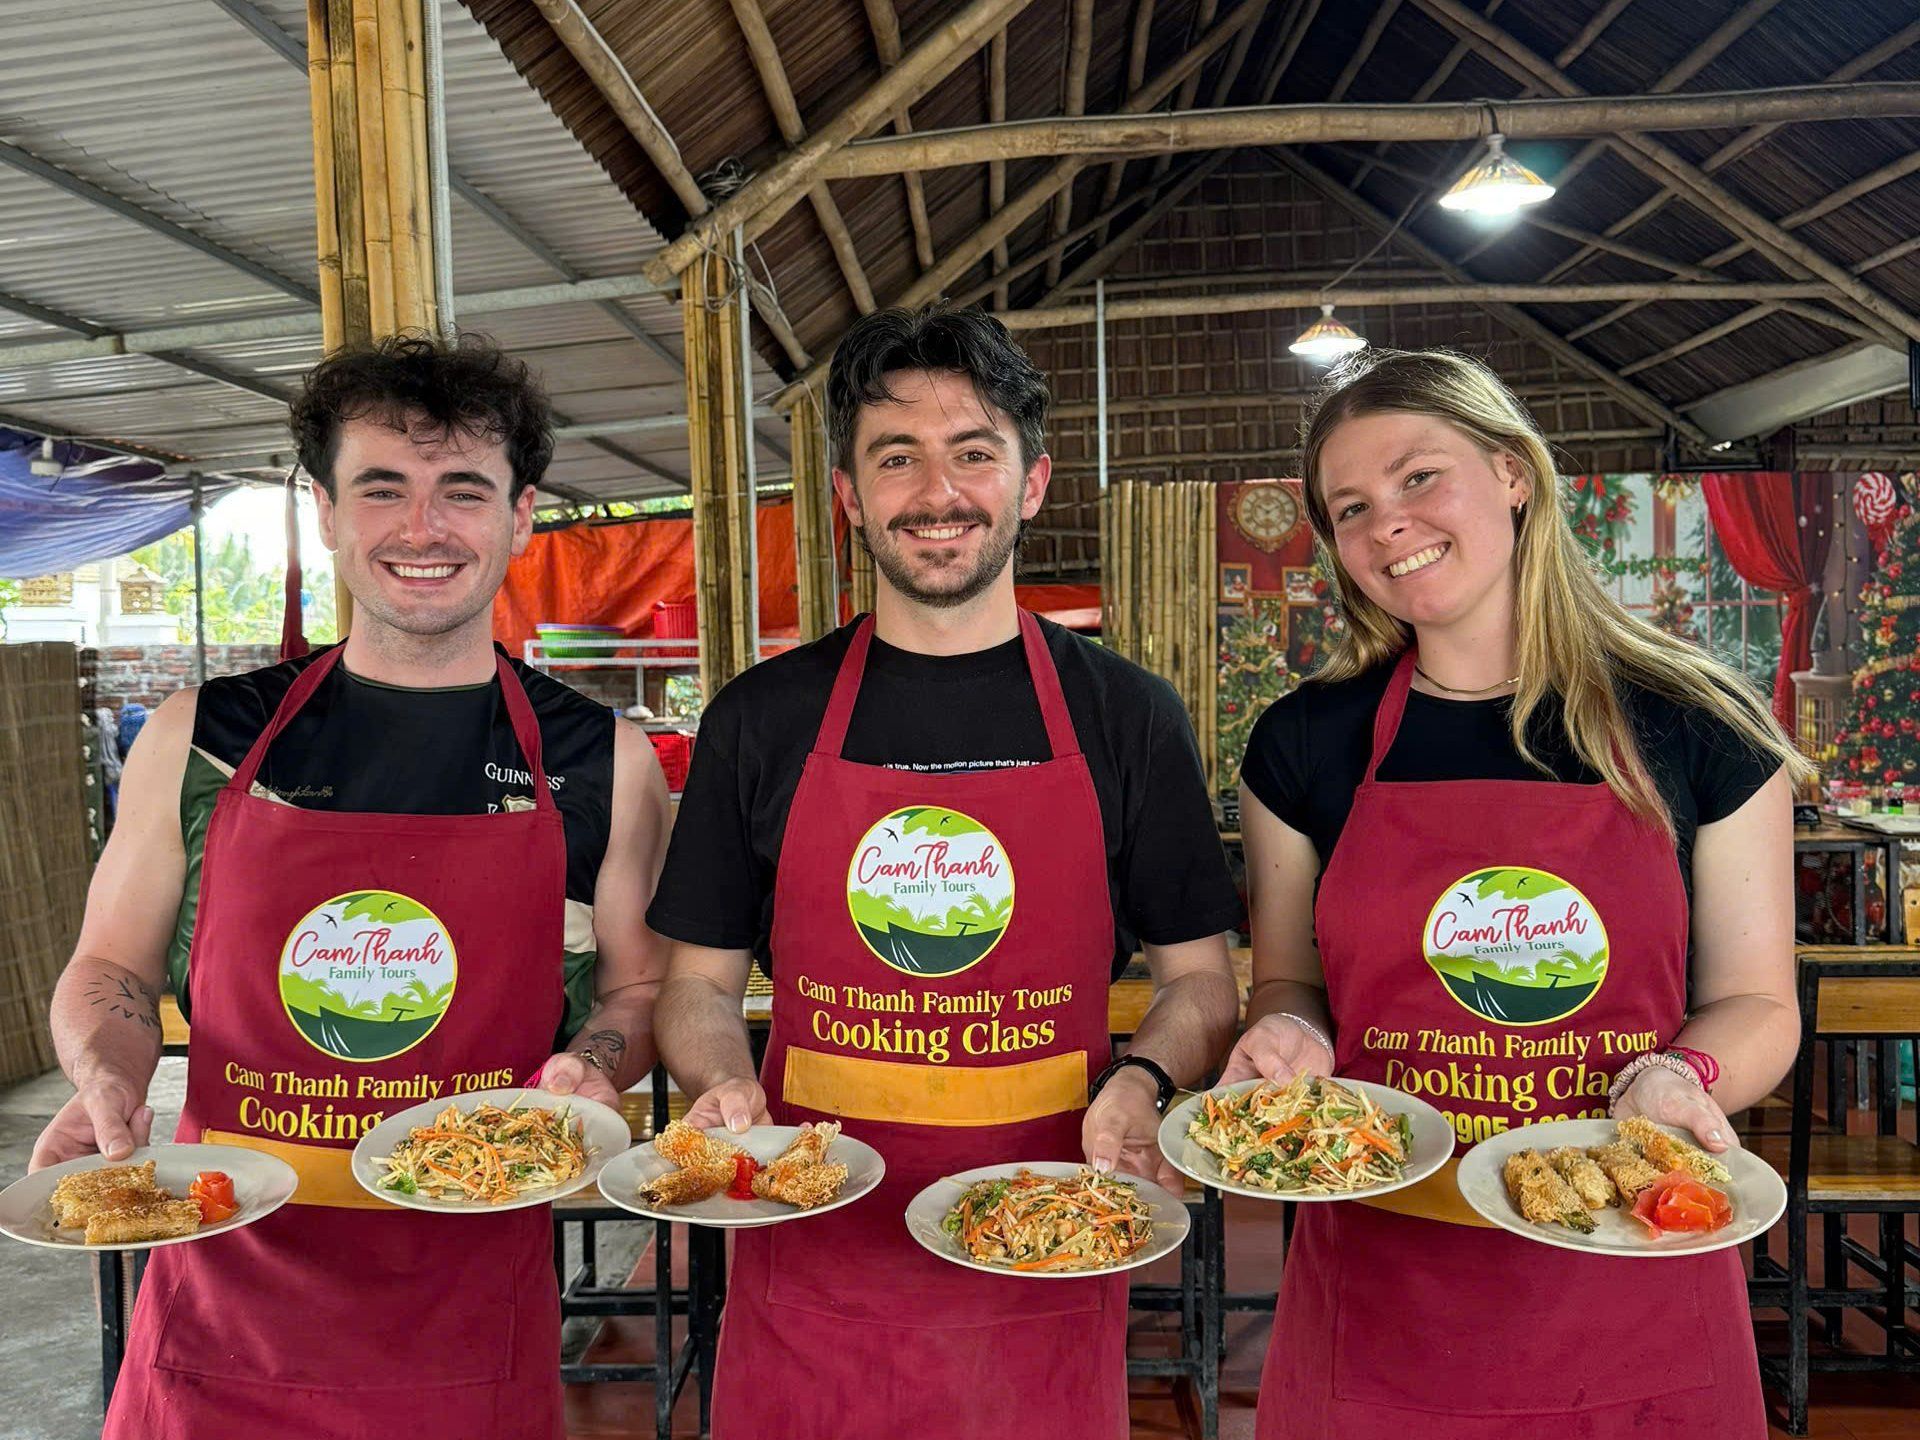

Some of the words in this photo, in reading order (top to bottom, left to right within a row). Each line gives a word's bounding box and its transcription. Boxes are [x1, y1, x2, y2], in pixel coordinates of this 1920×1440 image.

[484, 762, 565, 791] GUINNSS
[912, 763, 930, 771] Now
[943, 761, 968, 770] motion
[968, 761, 994, 769] picture
[1015, 760, 1030, 768] just
[857, 846, 922, 884] Cam
[914, 841, 1000, 879] Thanh
[893, 881, 937, 897] Family
[941, 880, 976, 893] Tours
[1432, 911, 1502, 950] Cam
[1492, 901, 1588, 943] Thanh
[292, 931, 360, 967] Cam
[353, 928, 443, 965] Thanh
[1474, 943, 1521, 955] Family
[1526, 939, 1565, 951] Tours
[329, 966, 374, 983] Family
[379, 967, 416, 979] Tours
[798, 975, 836, 1004] Cam
[843, 986, 915, 1013] Thanh
[923, 990, 1005, 1017] Family
[1012, 983, 1073, 1011] Tours
[812, 1010, 950, 1063] Cooking
[962, 1019, 1055, 1055] Class
[1363, 1027, 1409, 1050] Cam
[1417, 1029, 1496, 1057] Thanh
[1504, 1027, 1590, 1060] Family
[1597, 1028, 1658, 1054] Tours
[225, 1061, 265, 1091] Cam
[271, 1071, 349, 1098] Thanh
[355, 1074, 444, 1101] Family
[451, 1067, 513, 1094] Tours
[1385, 1059, 1538, 1112] Cooking
[1546, 1063, 1620, 1100] Cla
